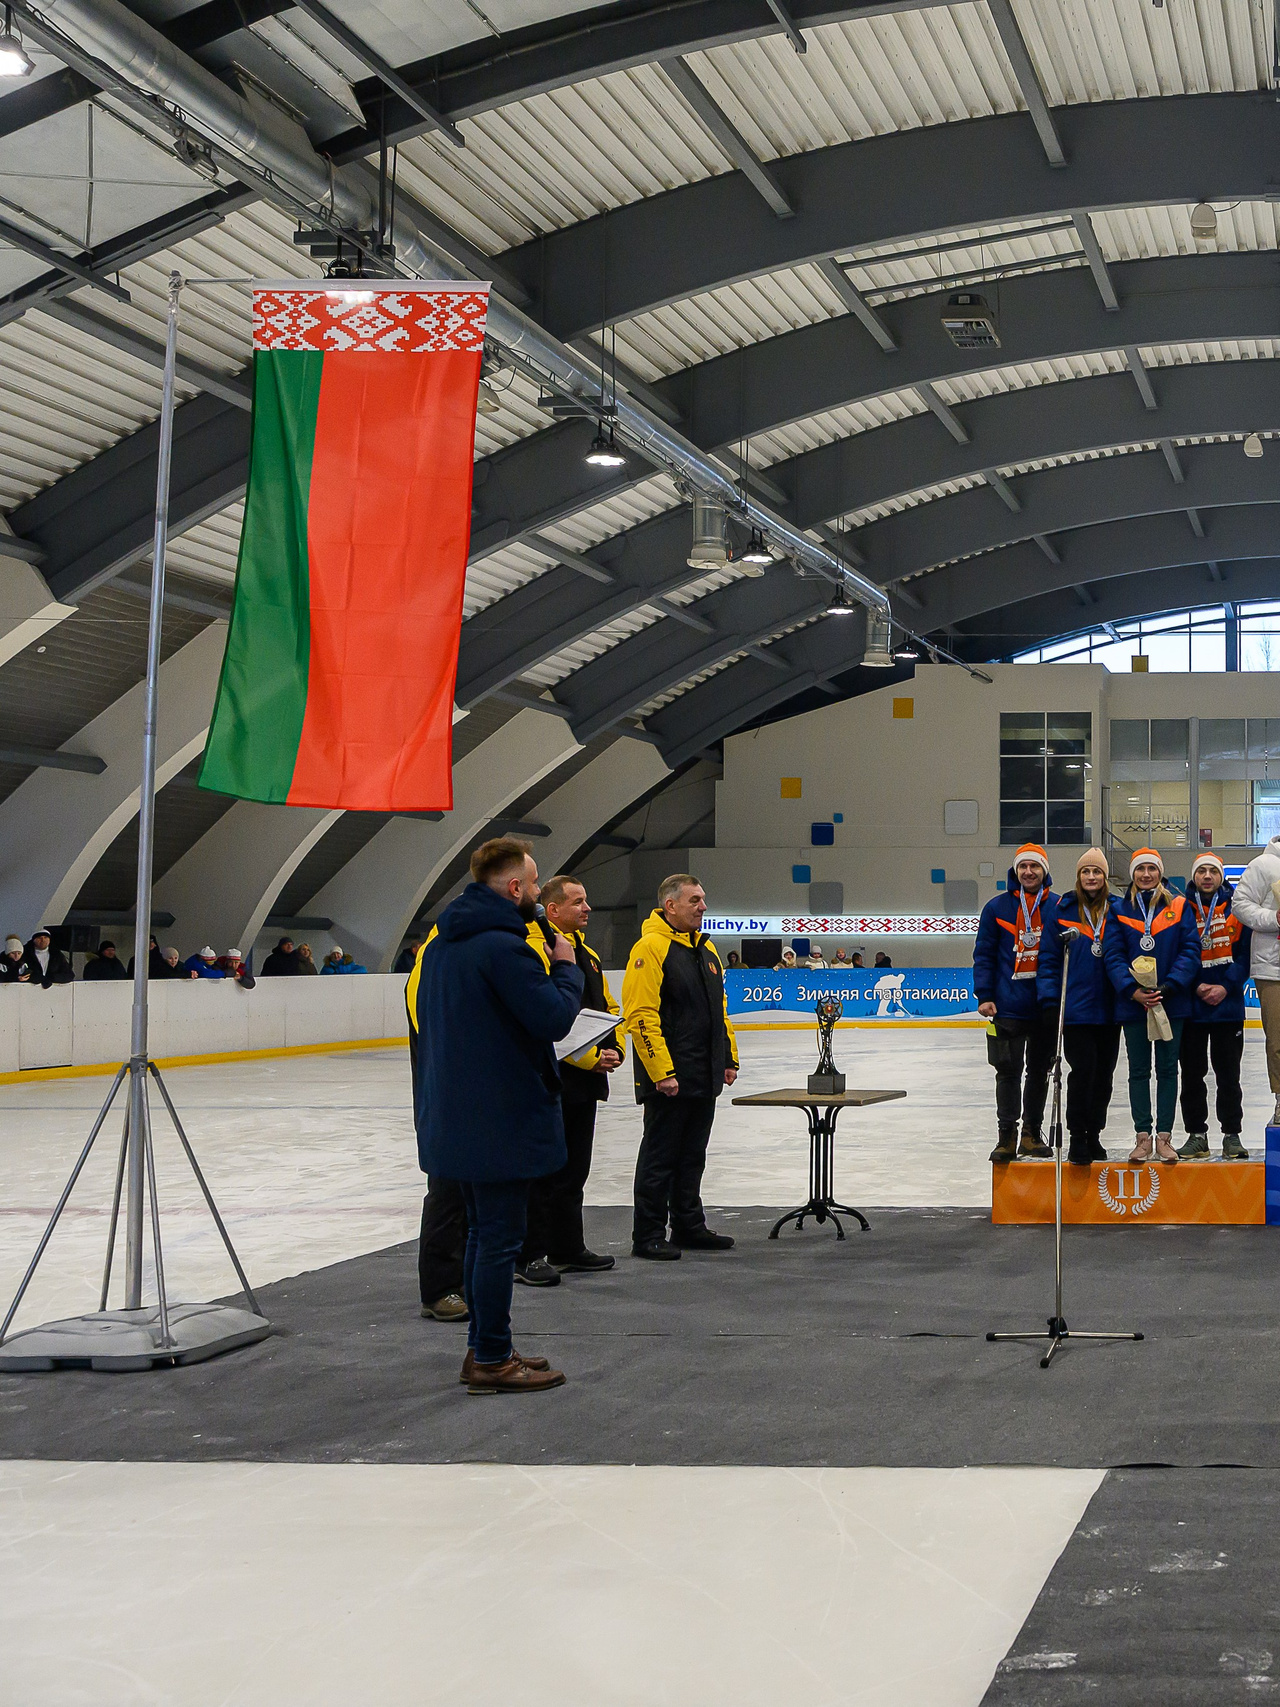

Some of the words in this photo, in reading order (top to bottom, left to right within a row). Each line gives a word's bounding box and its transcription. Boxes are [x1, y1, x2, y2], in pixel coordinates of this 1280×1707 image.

[701, 919, 768, 932] ilichy.by
[742, 987, 783, 1002] 2026
[796, 986, 859, 1001] Зимняя
[865, 988, 968, 1003] спартакиада
[638, 1019, 656, 1058] BELARUS
[1114, 1169, 1144, 1199] II
